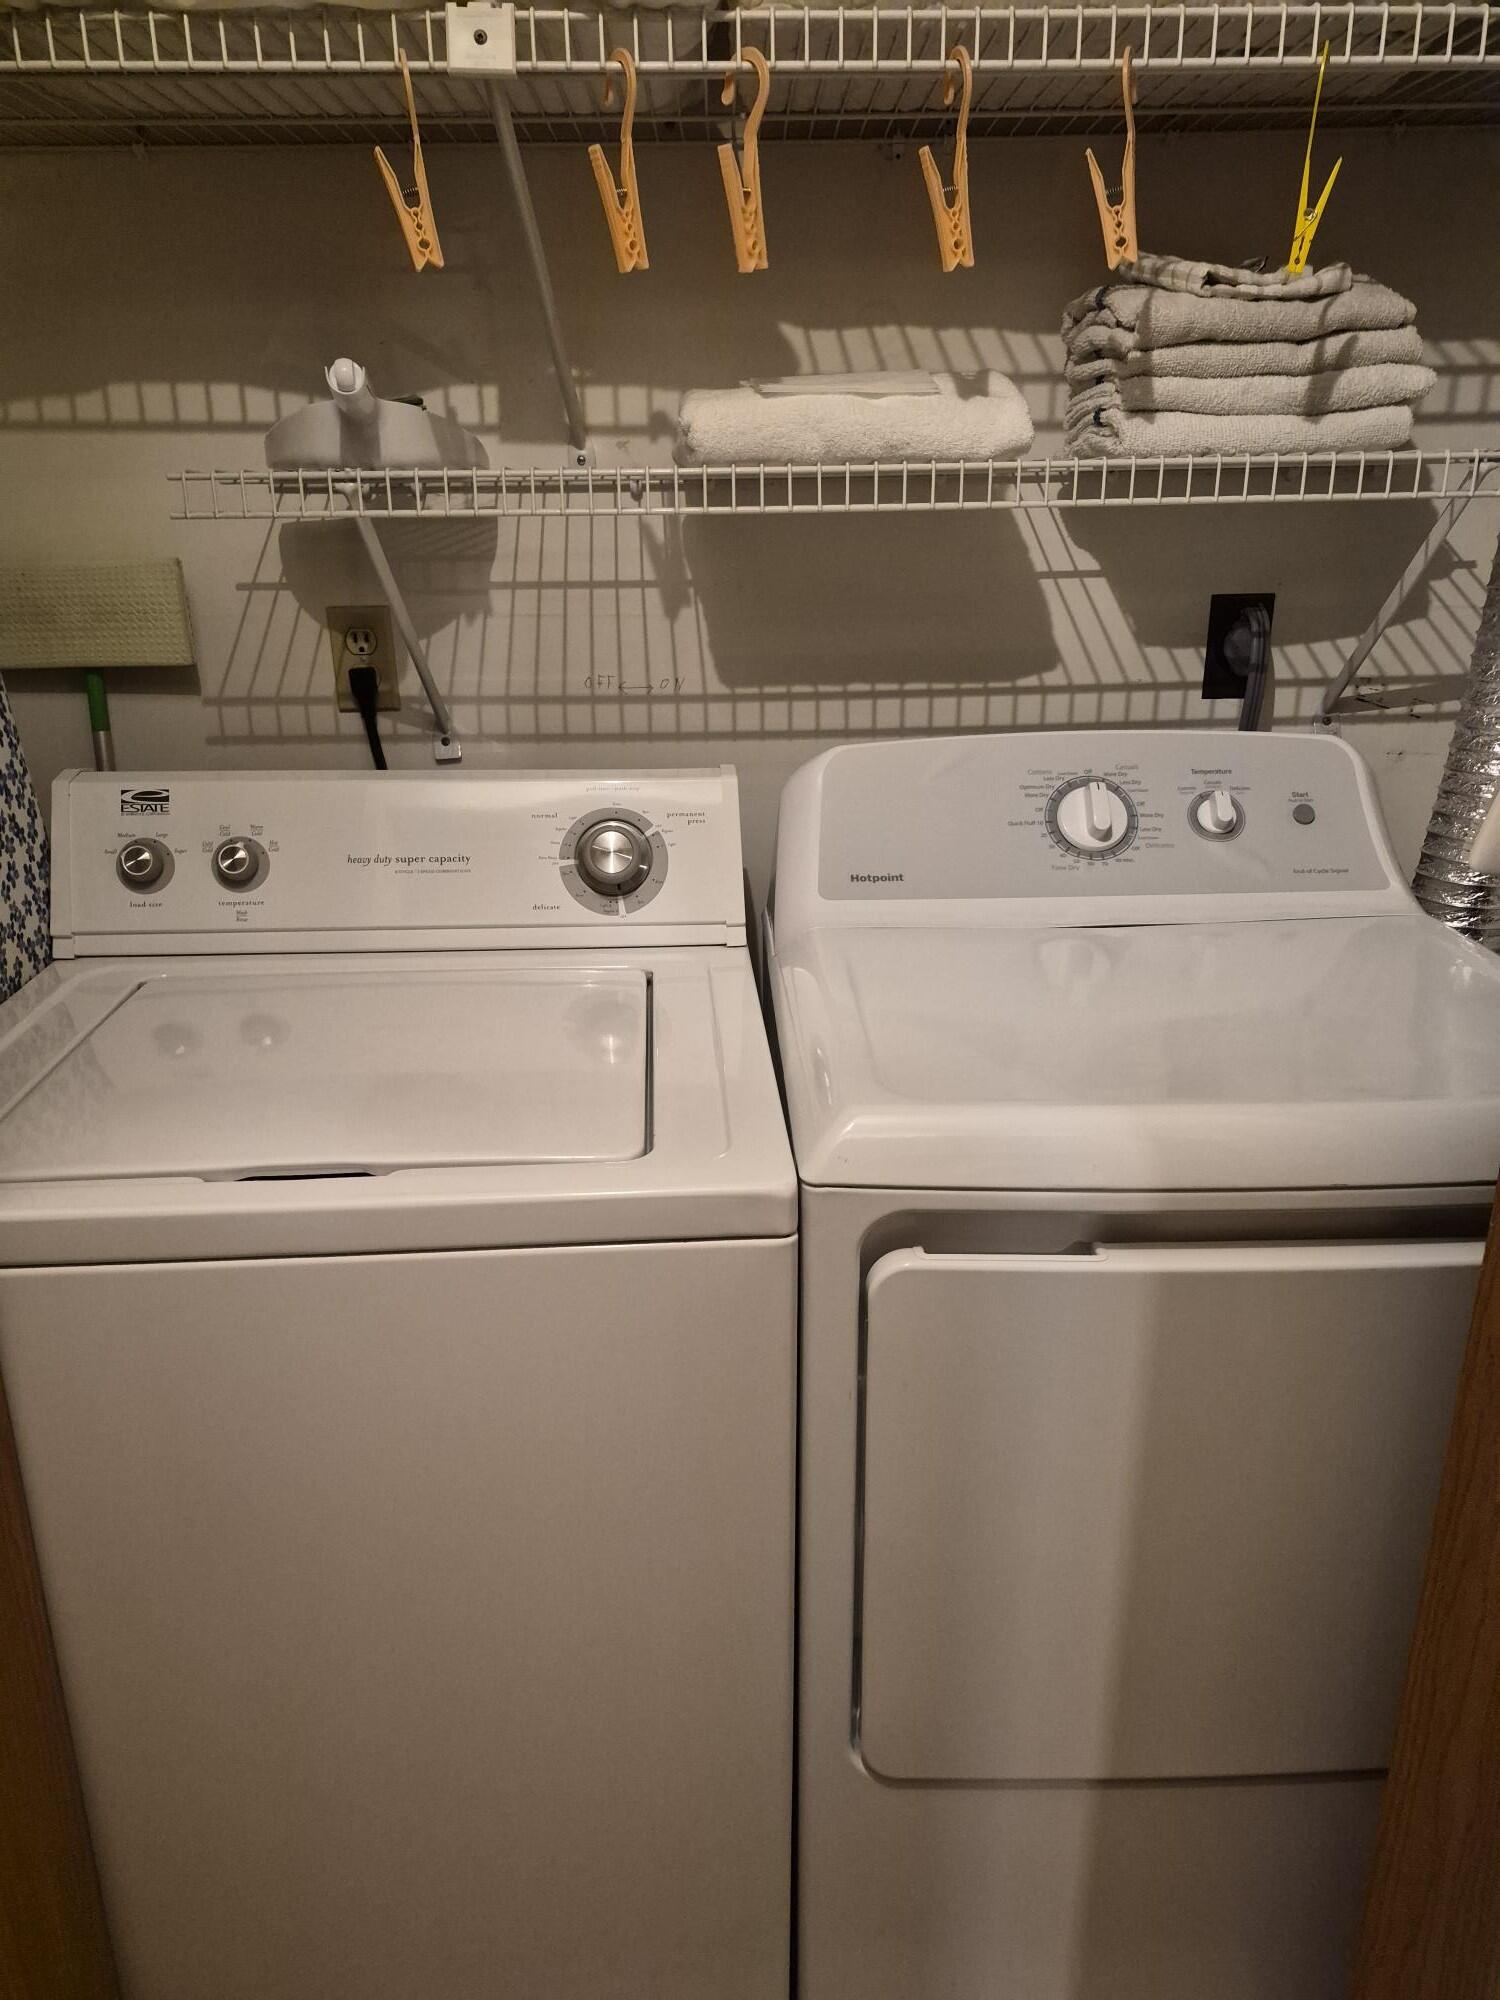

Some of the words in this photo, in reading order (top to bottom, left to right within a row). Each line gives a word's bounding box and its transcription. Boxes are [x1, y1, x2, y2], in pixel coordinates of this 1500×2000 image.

[1190, 768, 1232, 776] Temperature
[120, 803, 170, 813] ESTATE
[531, 811, 559, 819] normal
[666, 811, 706, 819] permanent
[687, 818, 706, 826] press
[346, 853, 371, 867] heavy
[373, 853, 392, 867] duty
[394, 855, 426, 866] super
[428, 853, 472, 866] capacity
[850, 873, 904, 883] Hotpoint
[218, 900, 264, 908] temperature
[532, 903, 560, 911] delicate
